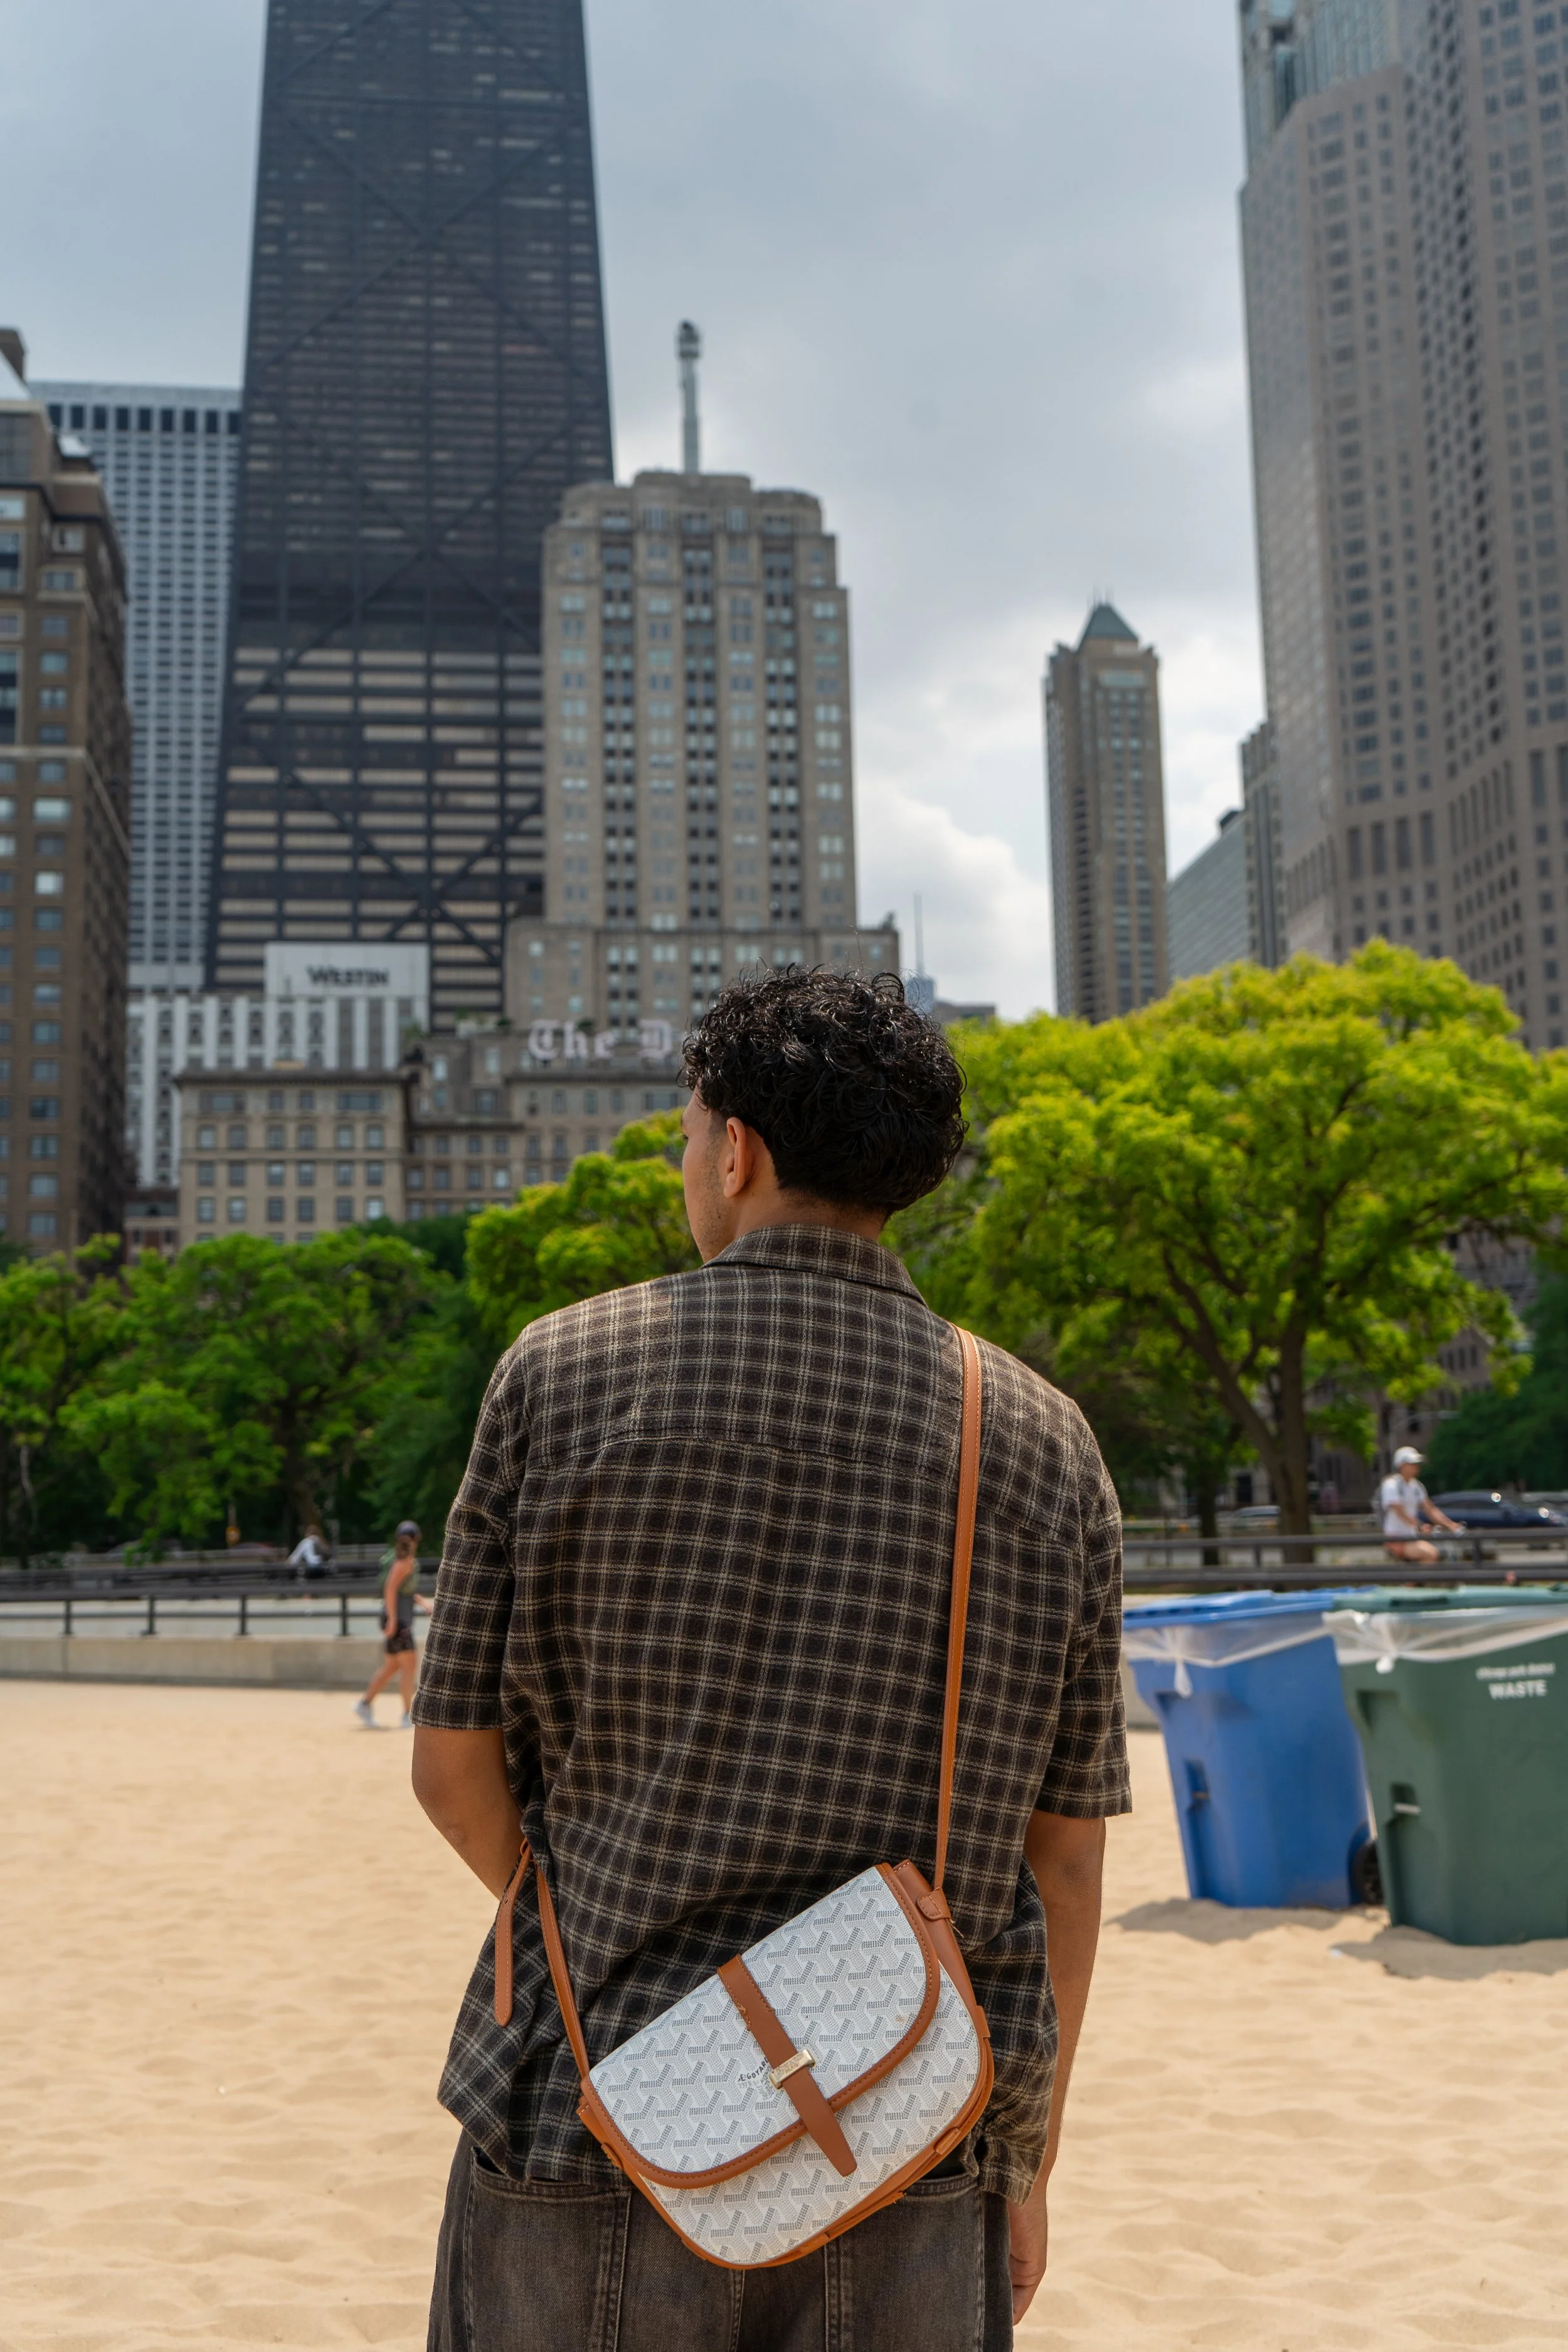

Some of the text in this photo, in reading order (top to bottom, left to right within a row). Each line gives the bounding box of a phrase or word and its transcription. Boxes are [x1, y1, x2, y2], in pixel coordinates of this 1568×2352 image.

[528, 1019, 672, 1060] The D
[1488, 1680, 1547, 1700] WASTE
